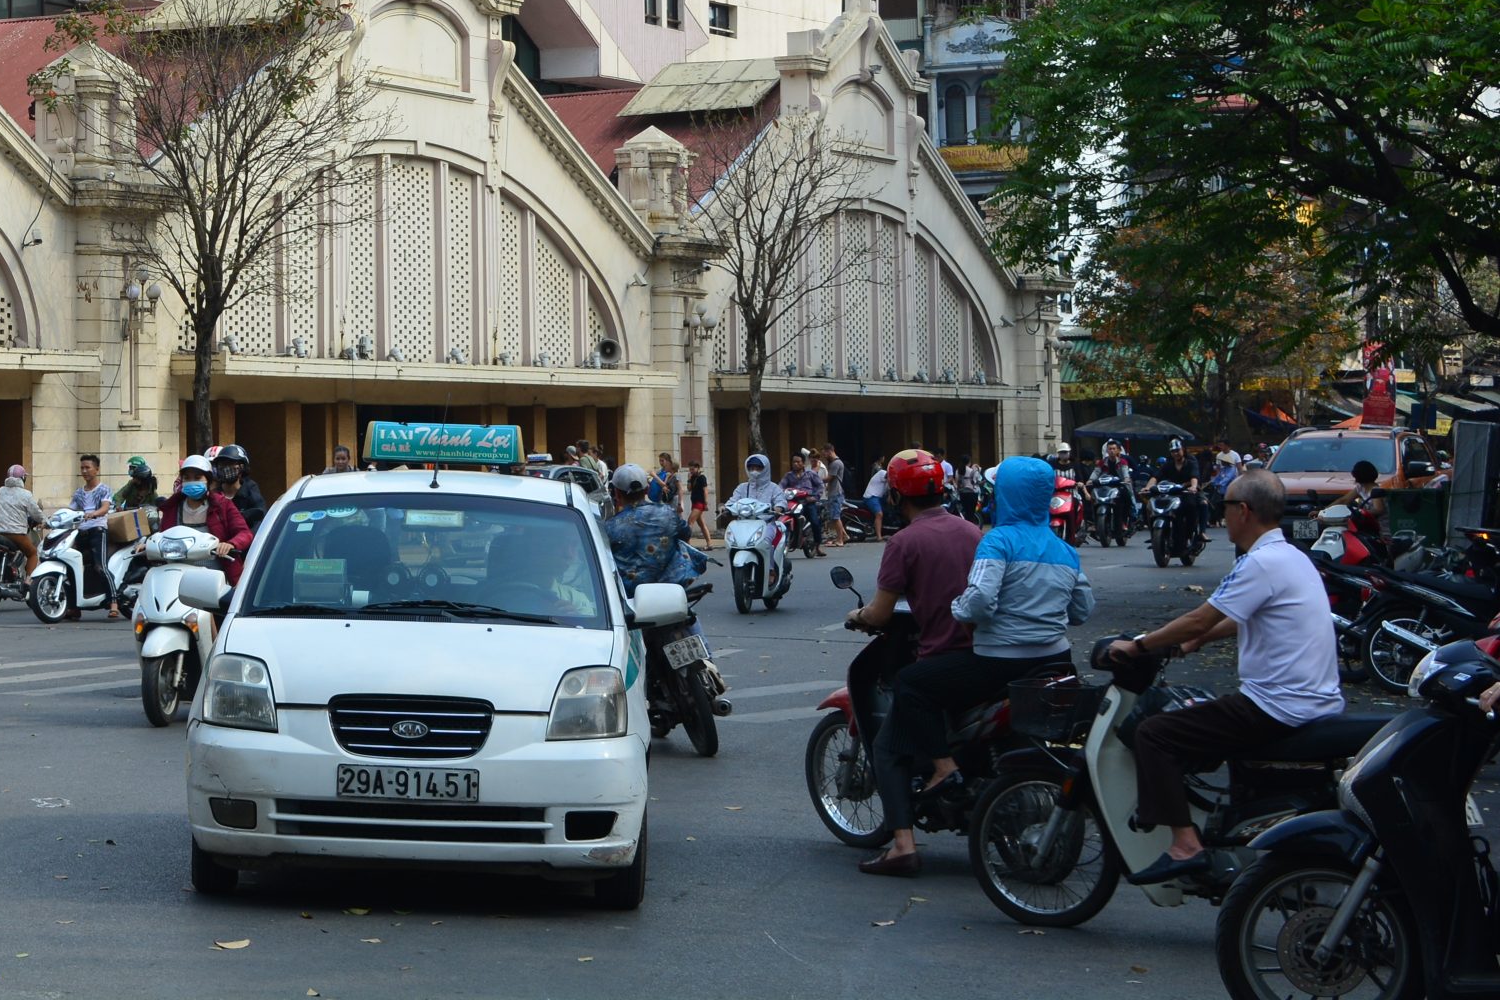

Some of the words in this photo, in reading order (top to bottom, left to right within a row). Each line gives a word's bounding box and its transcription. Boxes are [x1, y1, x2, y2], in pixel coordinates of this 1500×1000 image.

[379, 429, 414, 441] TAXI
[415, 427, 473, 448] Thành
[475, 429, 511, 453] Lợi
[398, 724, 422, 735] KIA
[342, 768, 472, 798] 29A-914.51
